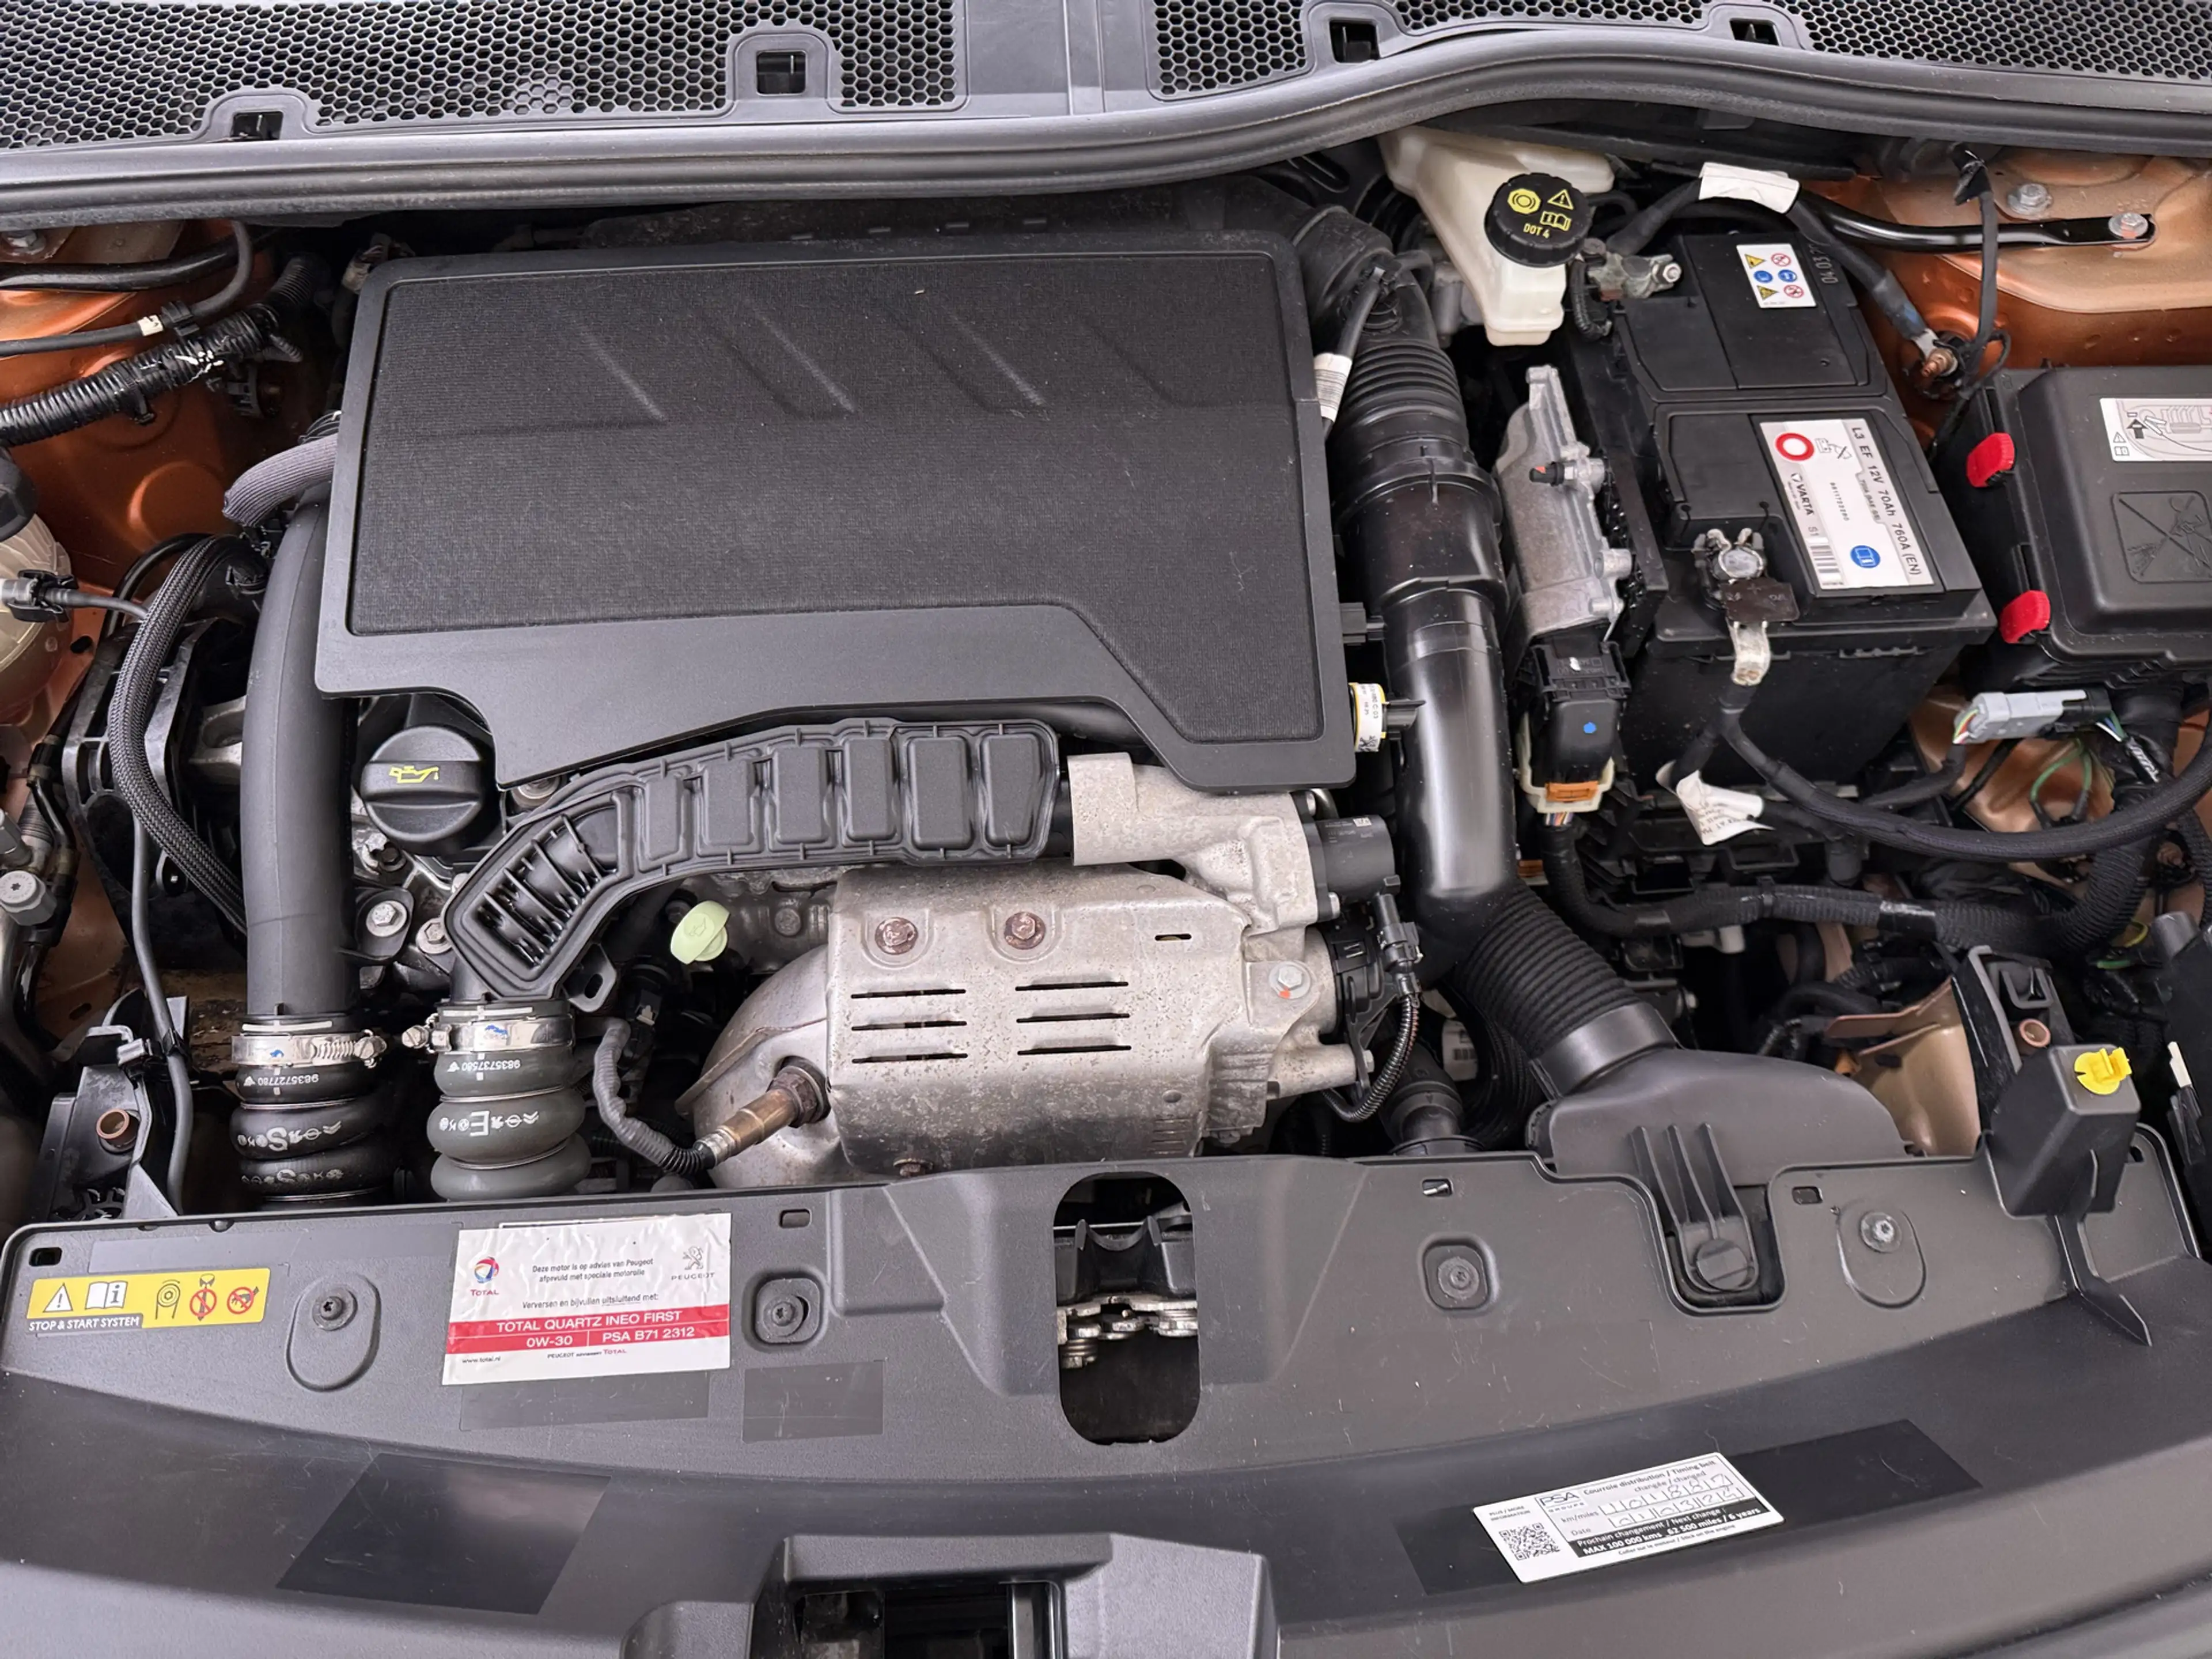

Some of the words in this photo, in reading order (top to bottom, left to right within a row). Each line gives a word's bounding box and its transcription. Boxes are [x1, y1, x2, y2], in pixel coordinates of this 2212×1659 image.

[1523, 223, 1543, 236] DOT
[1543, 229, 1550, 238] 4
[1797, 484, 1814, 516] VARTA
[1852, 427, 1865, 440] L3
[1859, 445, 1873, 459] EF
[1868, 465, 1884, 484] 12V
[1878, 490, 1896, 516] 70Ah
[1891, 522, 1911, 550] 760A
[1902, 554, 1922, 575] (EN)
[462, 1059, 520, 1071] 9835737580
[258, 1074, 319, 1086] 9835727780
[469, 1110, 490, 1137] E
[267, 1127, 287, 1152] S
[532, 1265, 548, 1273] Deze
[551, 1264, 570, 1272] motor
[626, 1258, 653, 1267] Peugeot
[584, 1270, 611, 1281] speciale
[613, 1269, 645, 1278] motorolie
[671, 1272, 715, 1280] PEUGEOT
[522, 1301, 558, 1309] Verversen
[570, 1297, 600, 1308] bijvullen
[602, 1294, 641, 1304] uitsluitend
[643, 1293, 659, 1301] met:
[29, 1320, 56, 1331] STOP
[57, 1320, 65, 1330] &
[67, 1318, 100, 1329] START
[100, 1316, 139, 1328] SYSTEM
[497, 1320, 540, 1332] TOTAL
[544, 1316, 602, 1330] QUARTZ
[605, 1313, 639, 1325] INEO
[643, 1310, 682, 1323] FIRST
[527, 1335, 573, 1348] 0W-30
[602, 1332, 630, 1343] PSA
[634, 1330, 658, 1340] B71
[662, 1327, 695, 1339] 2312
[1584, 1484, 1618, 1495] Courroie
[1619, 1473, 1666, 1487] distribution
[1671, 1464, 1699, 1475] Timing
[1699, 1460, 1716, 1468] belt
[1673, 1471, 1706, 1482] changed
[1540, 1492, 1580, 1506] PSA
[1561, 1510, 1599, 1523] km/miles
[1571, 1528, 1591, 1536] Date
[1577, 1534, 1613, 1547] Prochain
[1613, 1522, 1664, 1538] changement
[1672, 1516, 1692, 1525] Next
[1692, 1509, 1721, 1520] change
[1583, 1544, 1607, 1555] MAX
[1607, 1541, 1624, 1550] 100
[1624, 1537, 1642, 1546] 000
[1642, 1532, 1662, 1541] kms
[1667, 1527, 1679, 1535] 62
[1680, 1523, 1698, 1532] 500
[1698, 1517, 1722, 1528] miles
[1736, 1508, 1761, 1519] years
